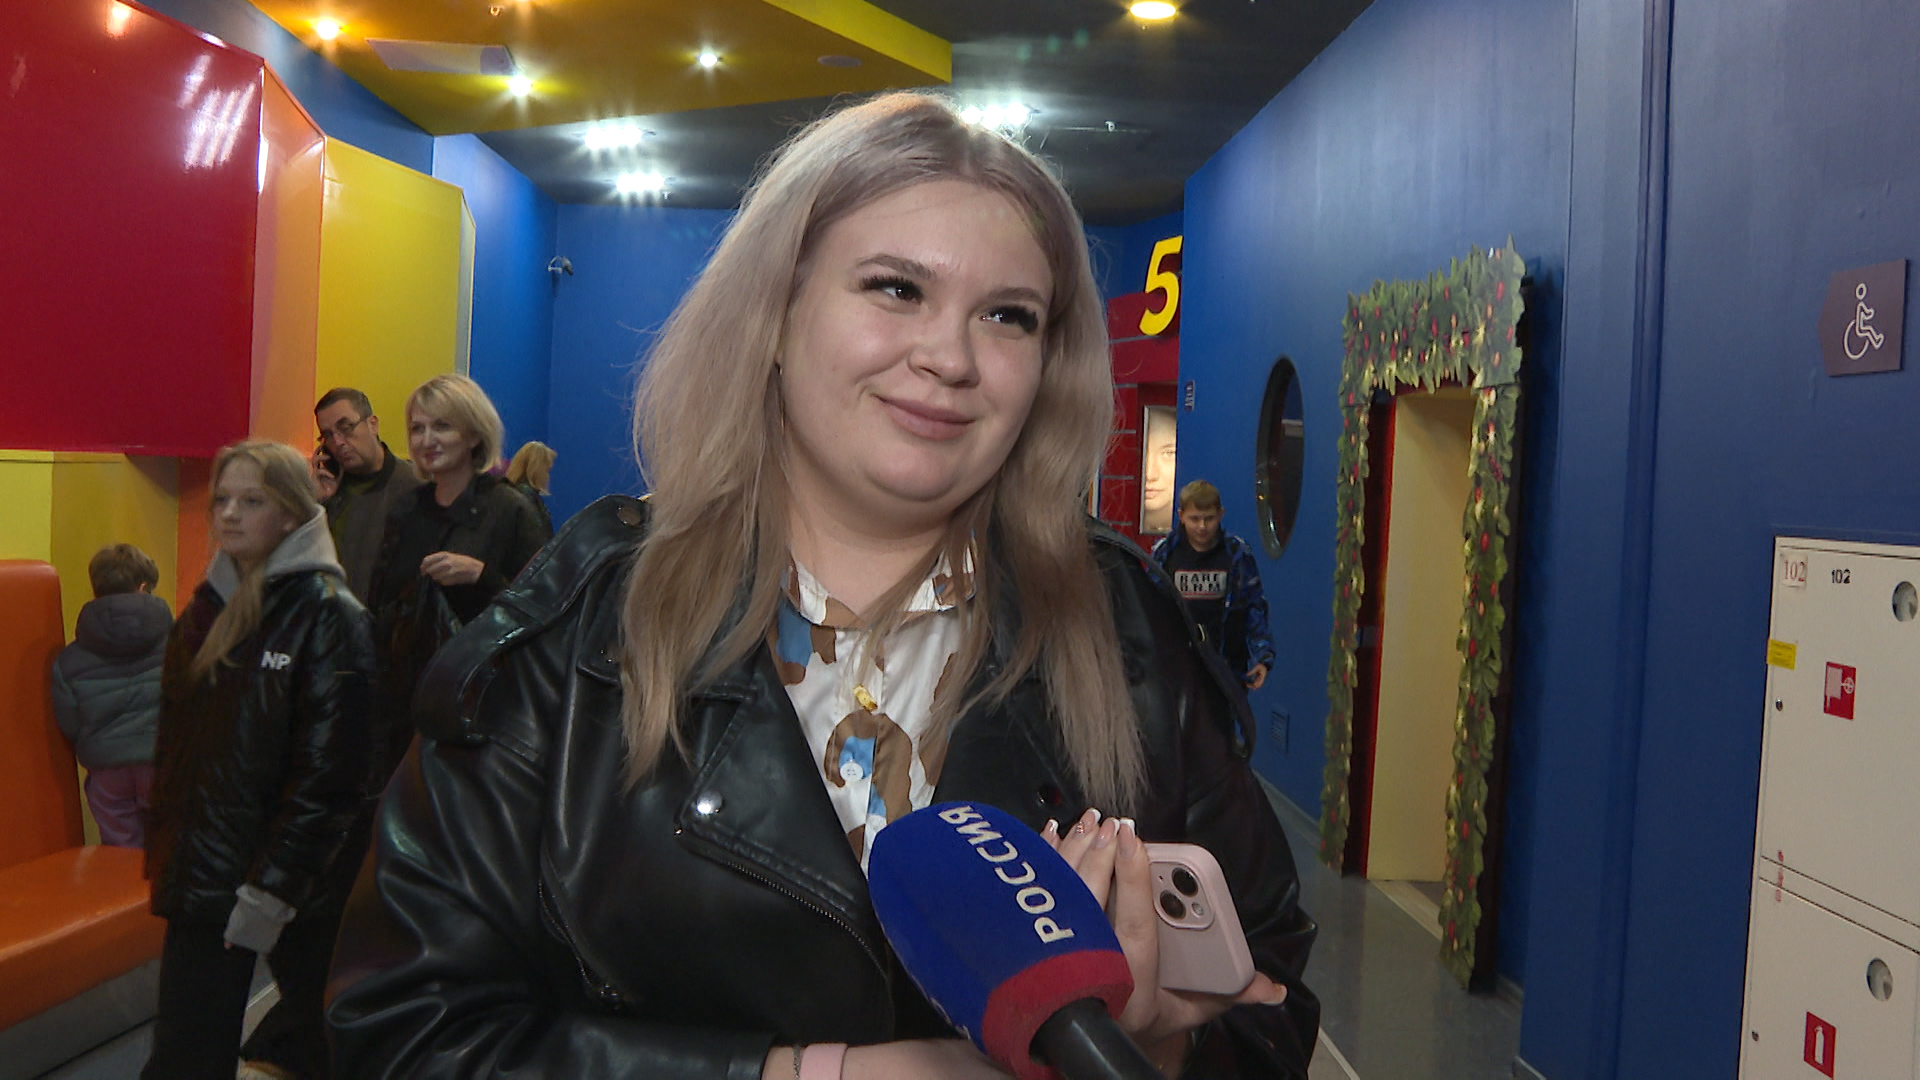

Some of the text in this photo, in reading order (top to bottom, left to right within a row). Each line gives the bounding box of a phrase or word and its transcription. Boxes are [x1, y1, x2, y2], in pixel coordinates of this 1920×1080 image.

[1139, 235, 1183, 336] 5
[1784, 559, 1807, 582] 102
[1831, 568, 1851, 584] 102
[261, 651, 291, 670] NP
[938, 805, 1075, 944] РОССИЯ
